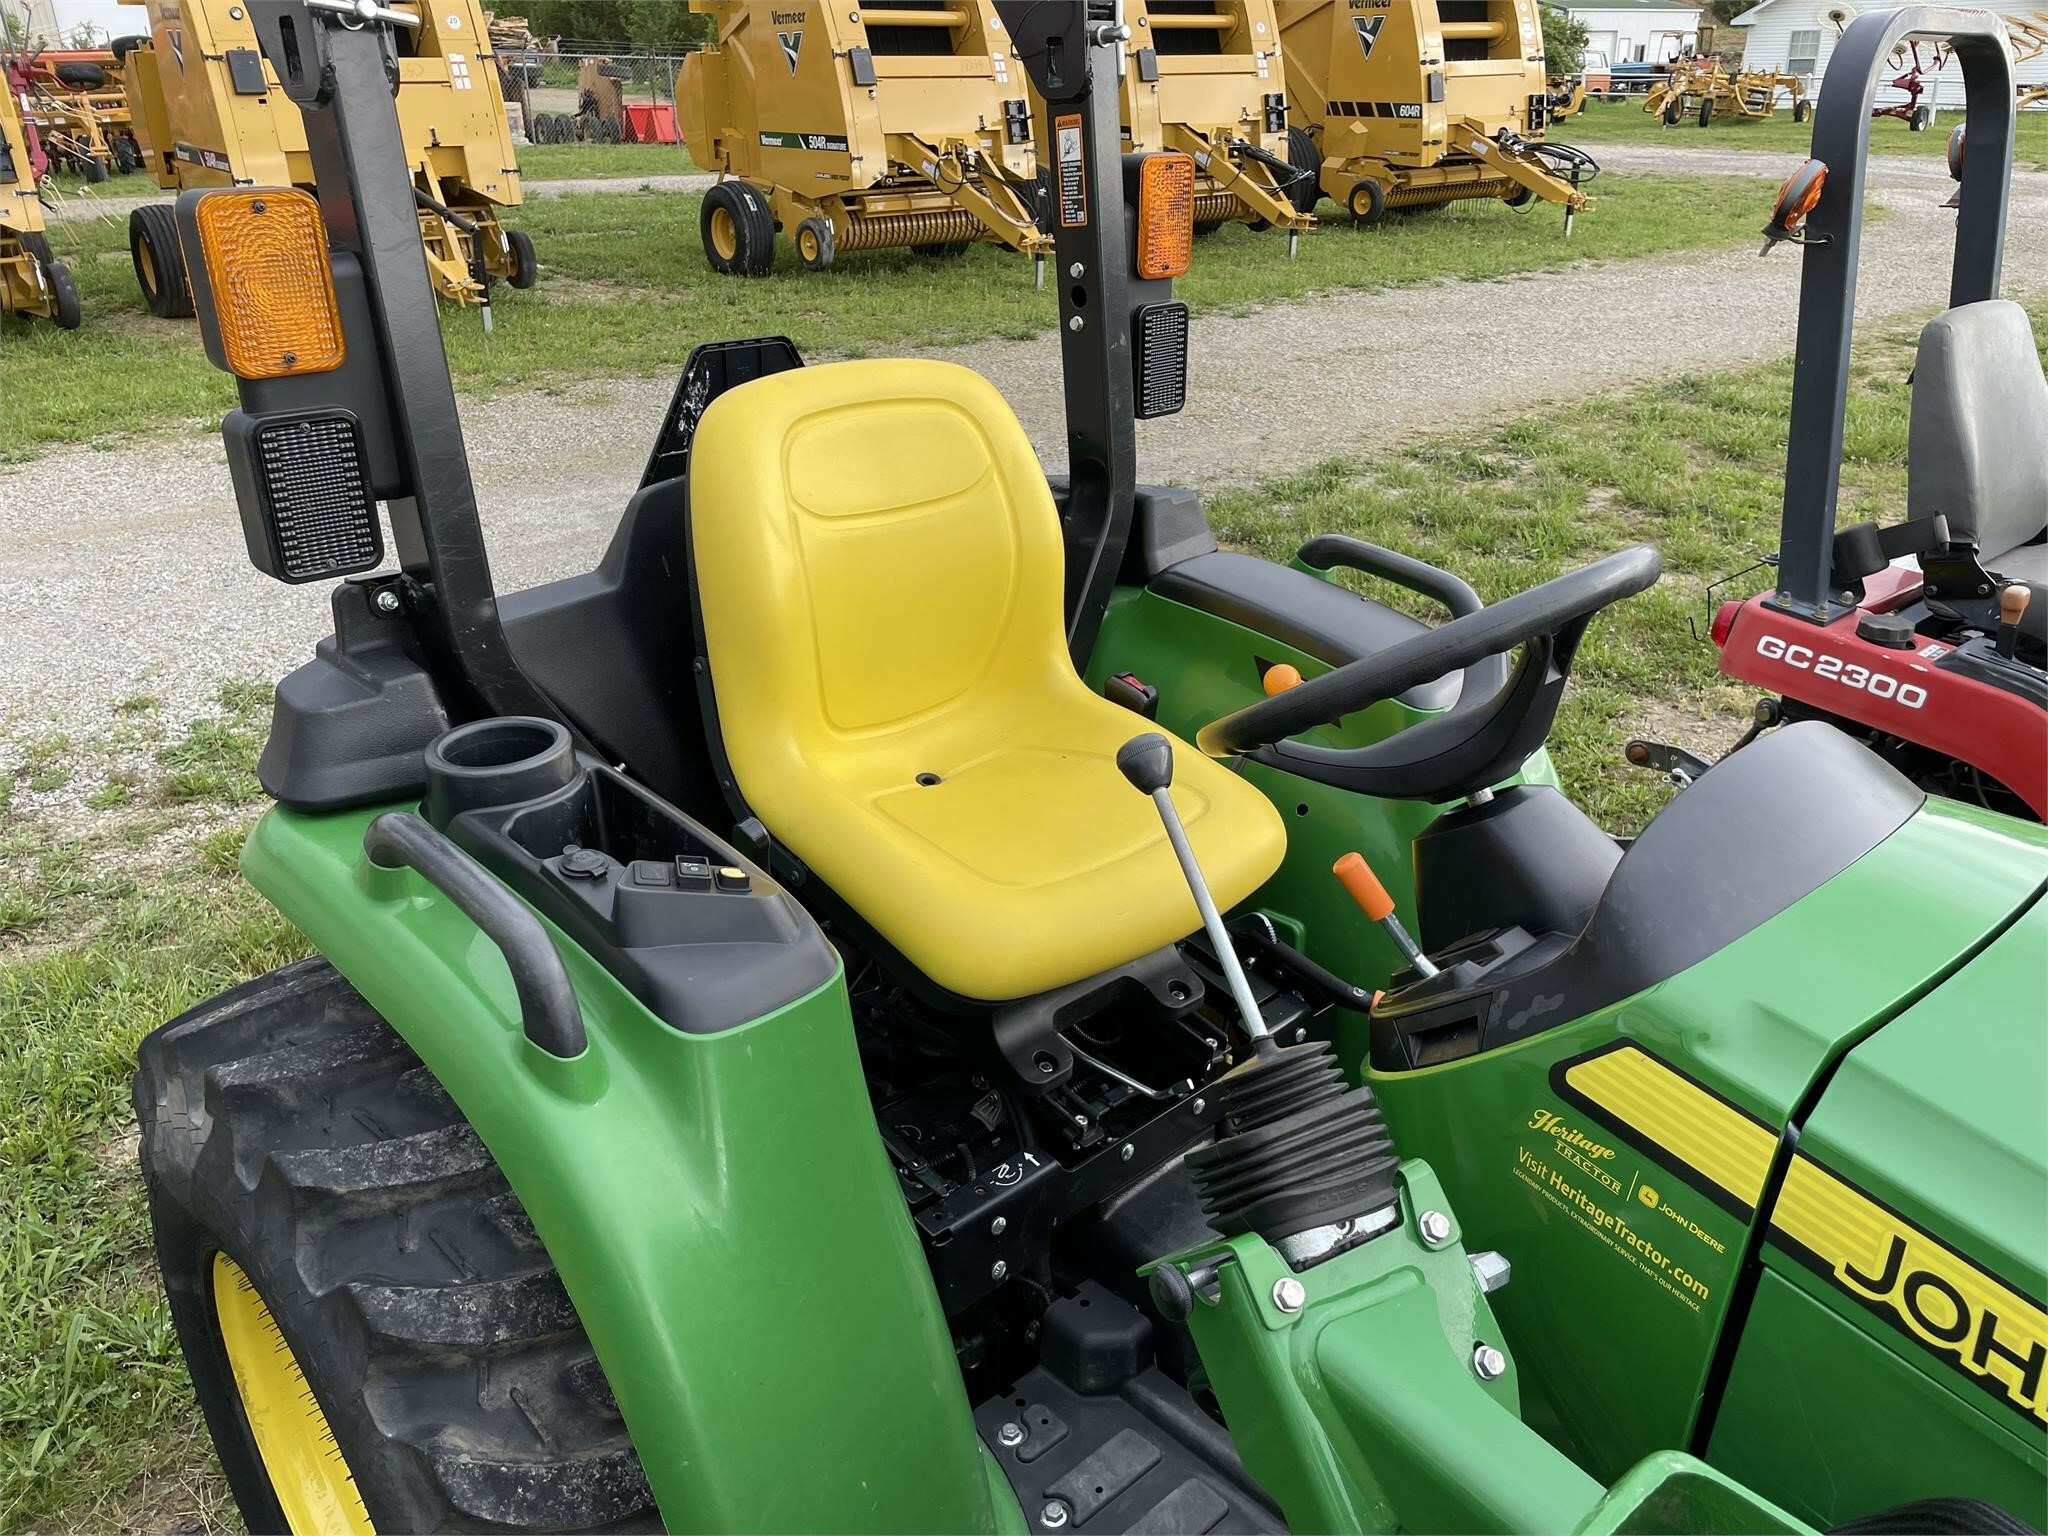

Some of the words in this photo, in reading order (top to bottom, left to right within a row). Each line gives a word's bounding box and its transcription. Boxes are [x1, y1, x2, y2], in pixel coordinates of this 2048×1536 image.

[771, 10, 806, 25] Vermeer
[1399, 104, 1420, 117] 604R
[808, 135, 827, 150] 504R
[1527, 1109, 1617, 1161] Heritage
[1554, 1141, 1623, 1192] TRACTOR
[1512, 1167, 1543, 1192] LEGENDARY
[1570, 1210, 1615, 1247] EXTRAORDINARY
[1658, 1277, 1673, 1291] OUR
[1518, 1146, 1548, 1180] Visit
[1549, 1170, 1710, 1301] HeritageTractor.com
[1658, 1203, 1689, 1228] JOHN
[1688, 1221, 1727, 1254] DEERE
[1844, 1233, 2048, 1402] JOH
